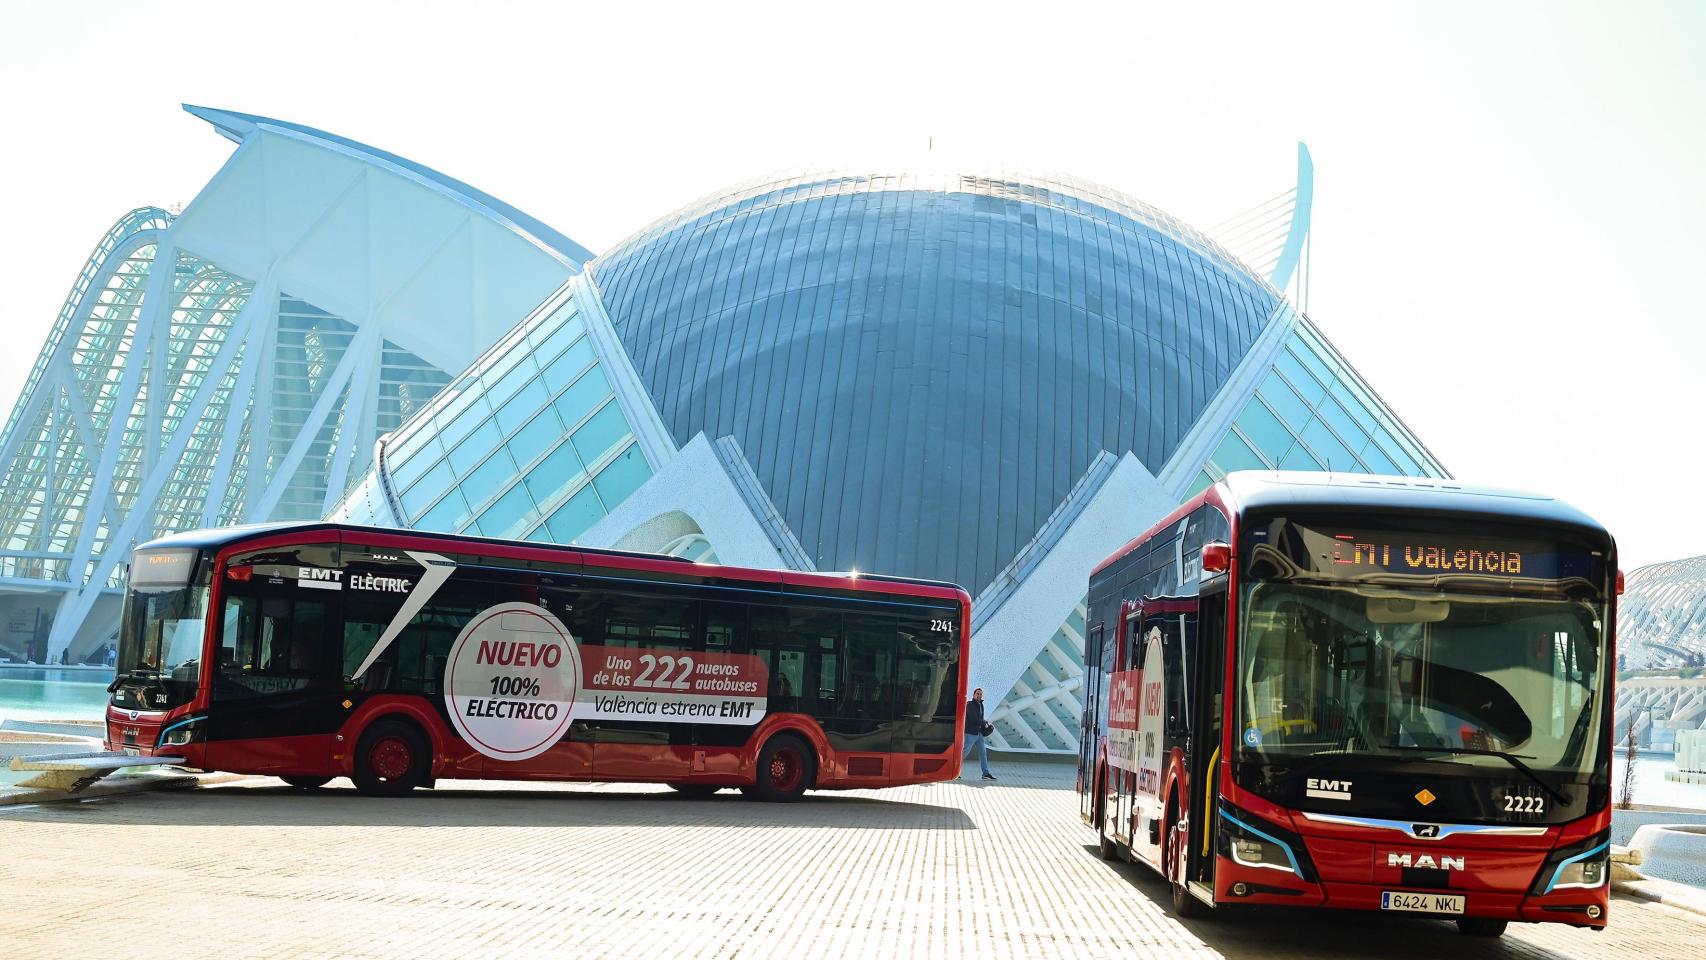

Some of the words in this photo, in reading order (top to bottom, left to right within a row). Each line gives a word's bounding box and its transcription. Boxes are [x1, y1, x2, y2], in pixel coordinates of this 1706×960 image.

[299, 567, 344, 581] EMT
[350, 572, 409, 593] ELÈCTRIC
[930, 619, 953, 633] 2241
[475, 640, 562, 668] NUEVO
[606, 655, 632, 670] Uno
[633, 654, 694, 690] 222
[696, 662, 740, 676] nuevos
[490, 676, 541, 697] 100%
[592, 670, 608, 686] de
[611, 671, 631, 687] los
[695, 677, 758, 693] autobuses
[465, 697, 558, 721] ELÉCTRICO
[594, 695, 657, 715] València
[661, 702, 716, 717] estrena
[719, 701, 755, 718] EMT
[1306, 778, 1353, 792] EMT
[1504, 795, 1544, 813] 2222
[1387, 852, 1465, 871] MAN
[1393, 895, 1428, 910] 6424
[1435, 897, 1461, 912] NKL
